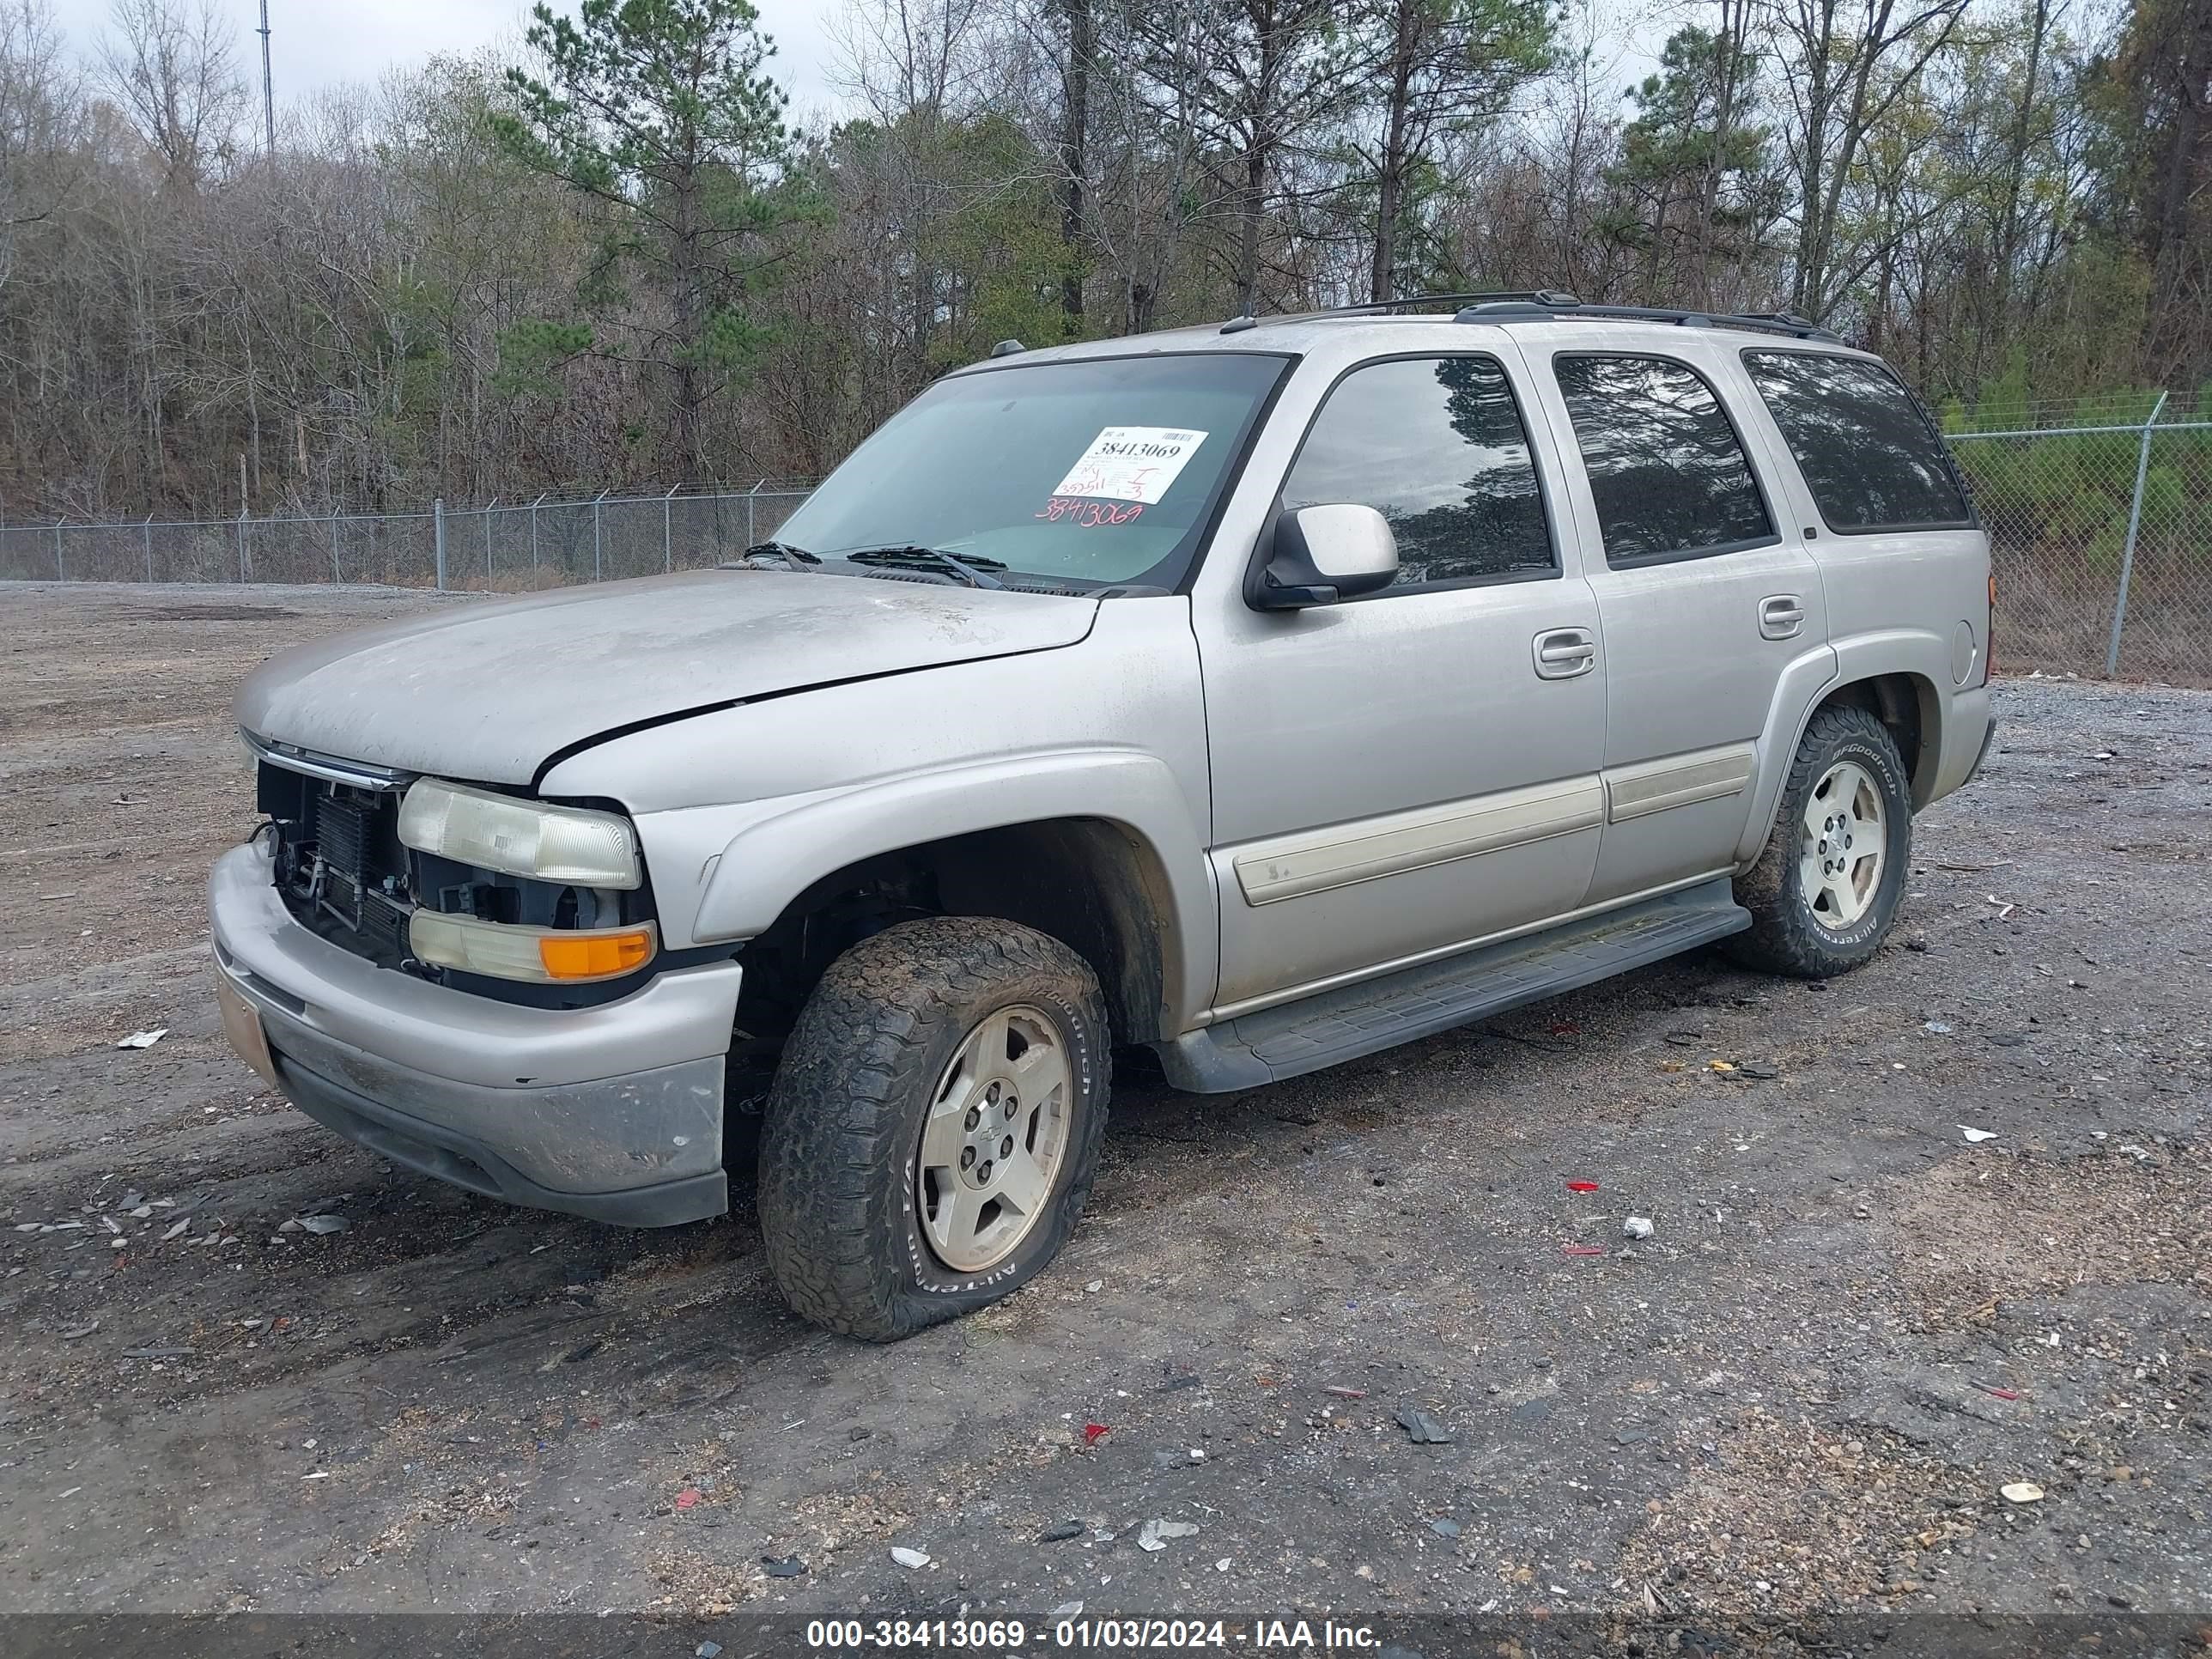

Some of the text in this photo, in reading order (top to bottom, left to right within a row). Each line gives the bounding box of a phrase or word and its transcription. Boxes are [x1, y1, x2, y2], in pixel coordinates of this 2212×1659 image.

[1095, 441, 1181, 459] 38413069
[1036, 497, 1145, 528] 38413069
[1831, 742, 1898, 797] BFGoodrich
